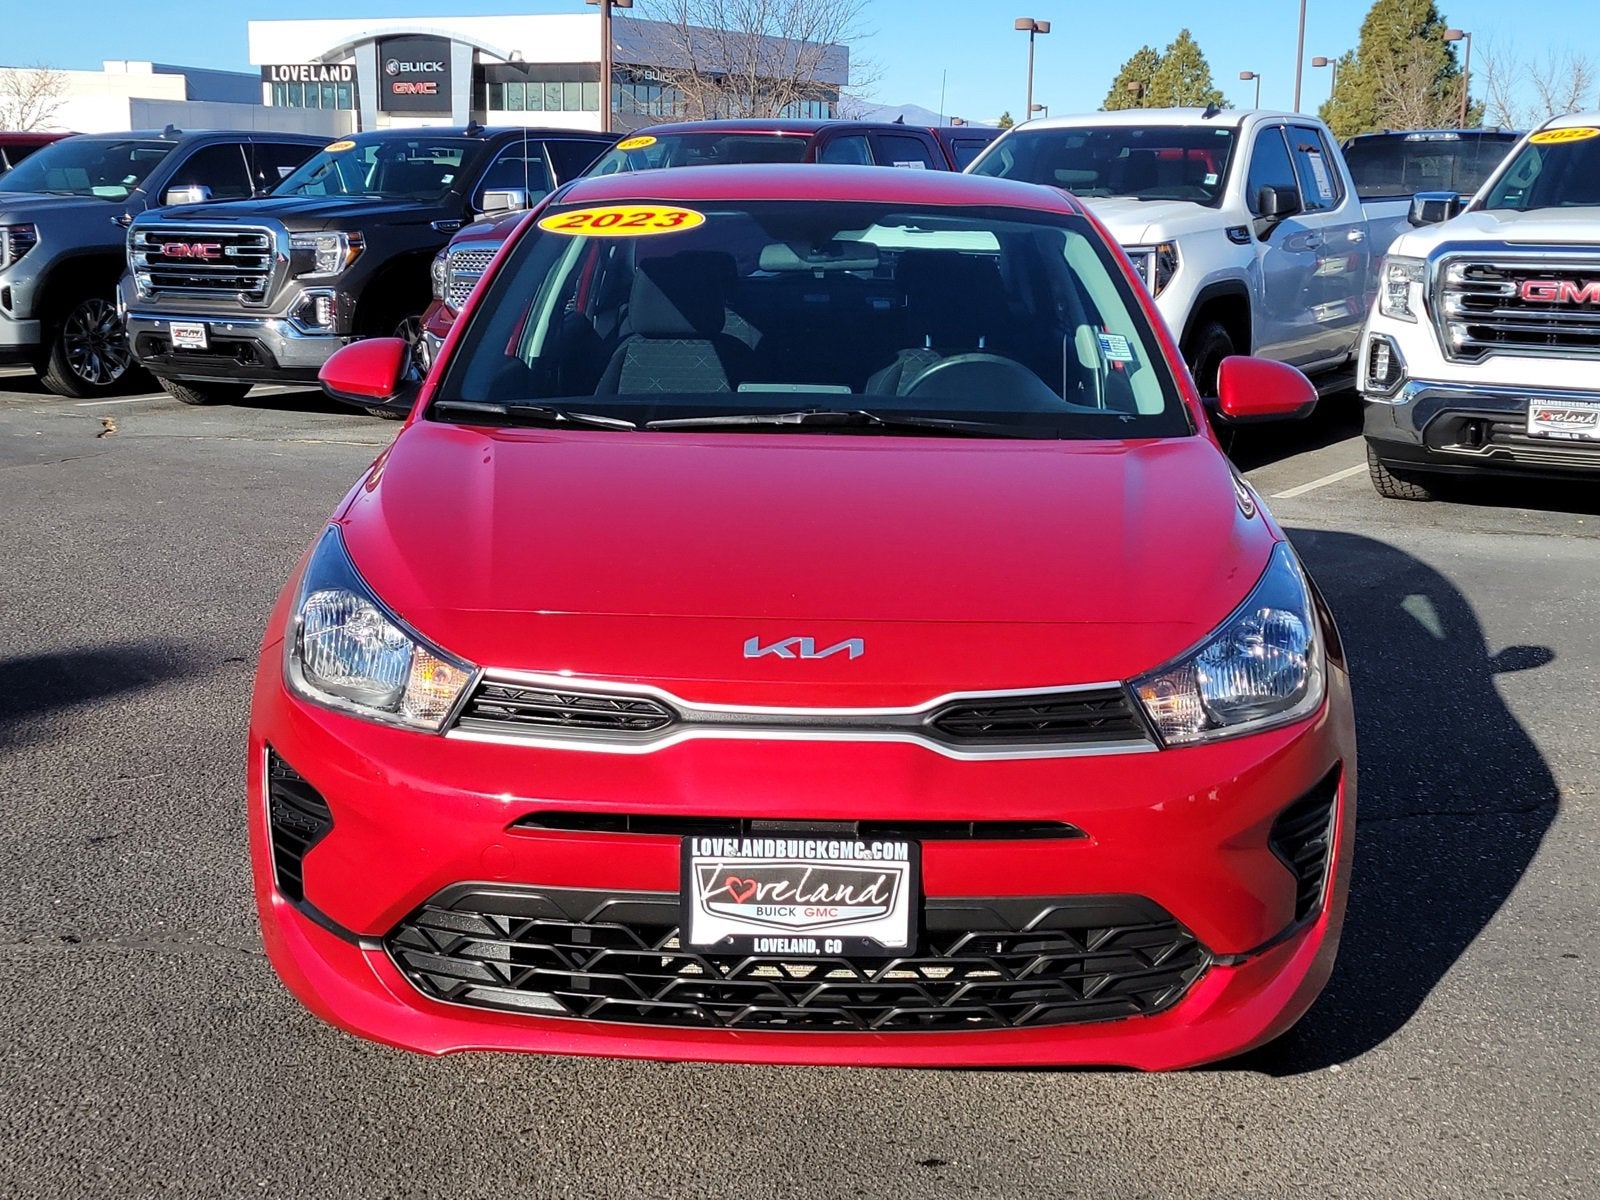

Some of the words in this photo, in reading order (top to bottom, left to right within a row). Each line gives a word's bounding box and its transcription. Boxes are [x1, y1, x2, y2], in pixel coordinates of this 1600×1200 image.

[271, 65, 352, 82] LOVELAND
[400, 61, 445, 73] BUICK
[644, 70, 677, 84] BUICK
[392, 82, 438, 95] GMC
[1534, 129, 1596, 142] 2022
[554, 212, 689, 229] 2023
[164, 242, 221, 258] GMC
[743, 635, 864, 660] KIA
[691, 838, 908, 861] LOVELANDBUICKGMCCOM
[756, 906, 796, 917] BUICK
[804, 908, 839, 917] GMC
[754, 937, 820, 955] LOVELAND,
[825, 939, 842, 954] CO
